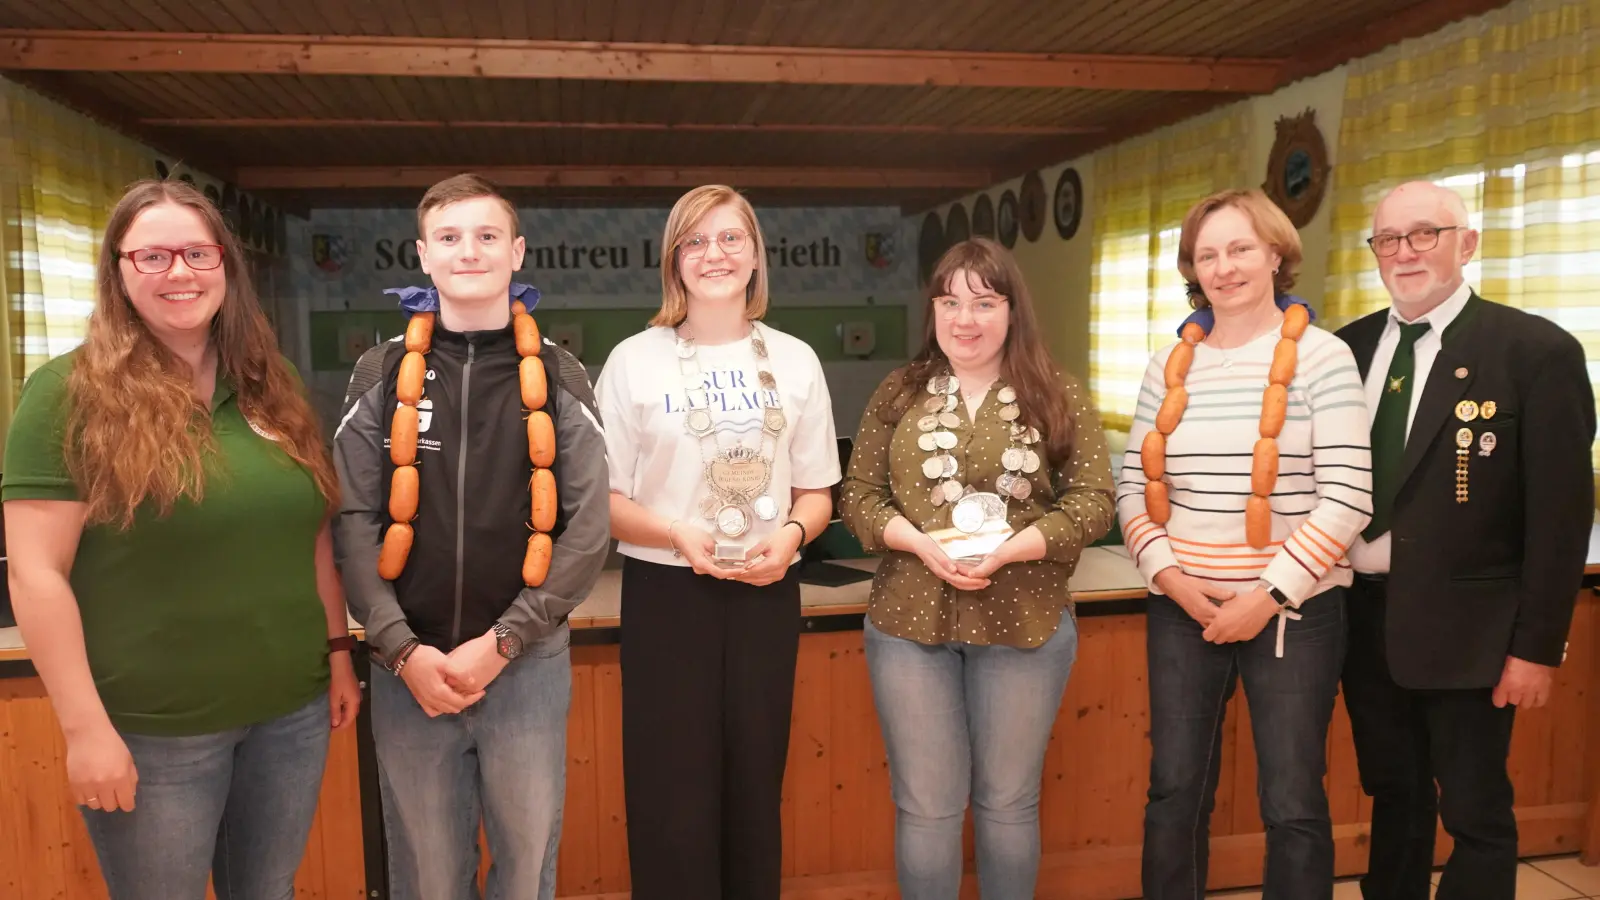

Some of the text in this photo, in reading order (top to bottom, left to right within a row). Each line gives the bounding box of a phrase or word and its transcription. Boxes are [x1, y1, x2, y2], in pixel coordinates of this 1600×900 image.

[375, 238, 421, 270] SG
[521, 239, 629, 269] rntreu
[703, 370, 747, 390] SUR
